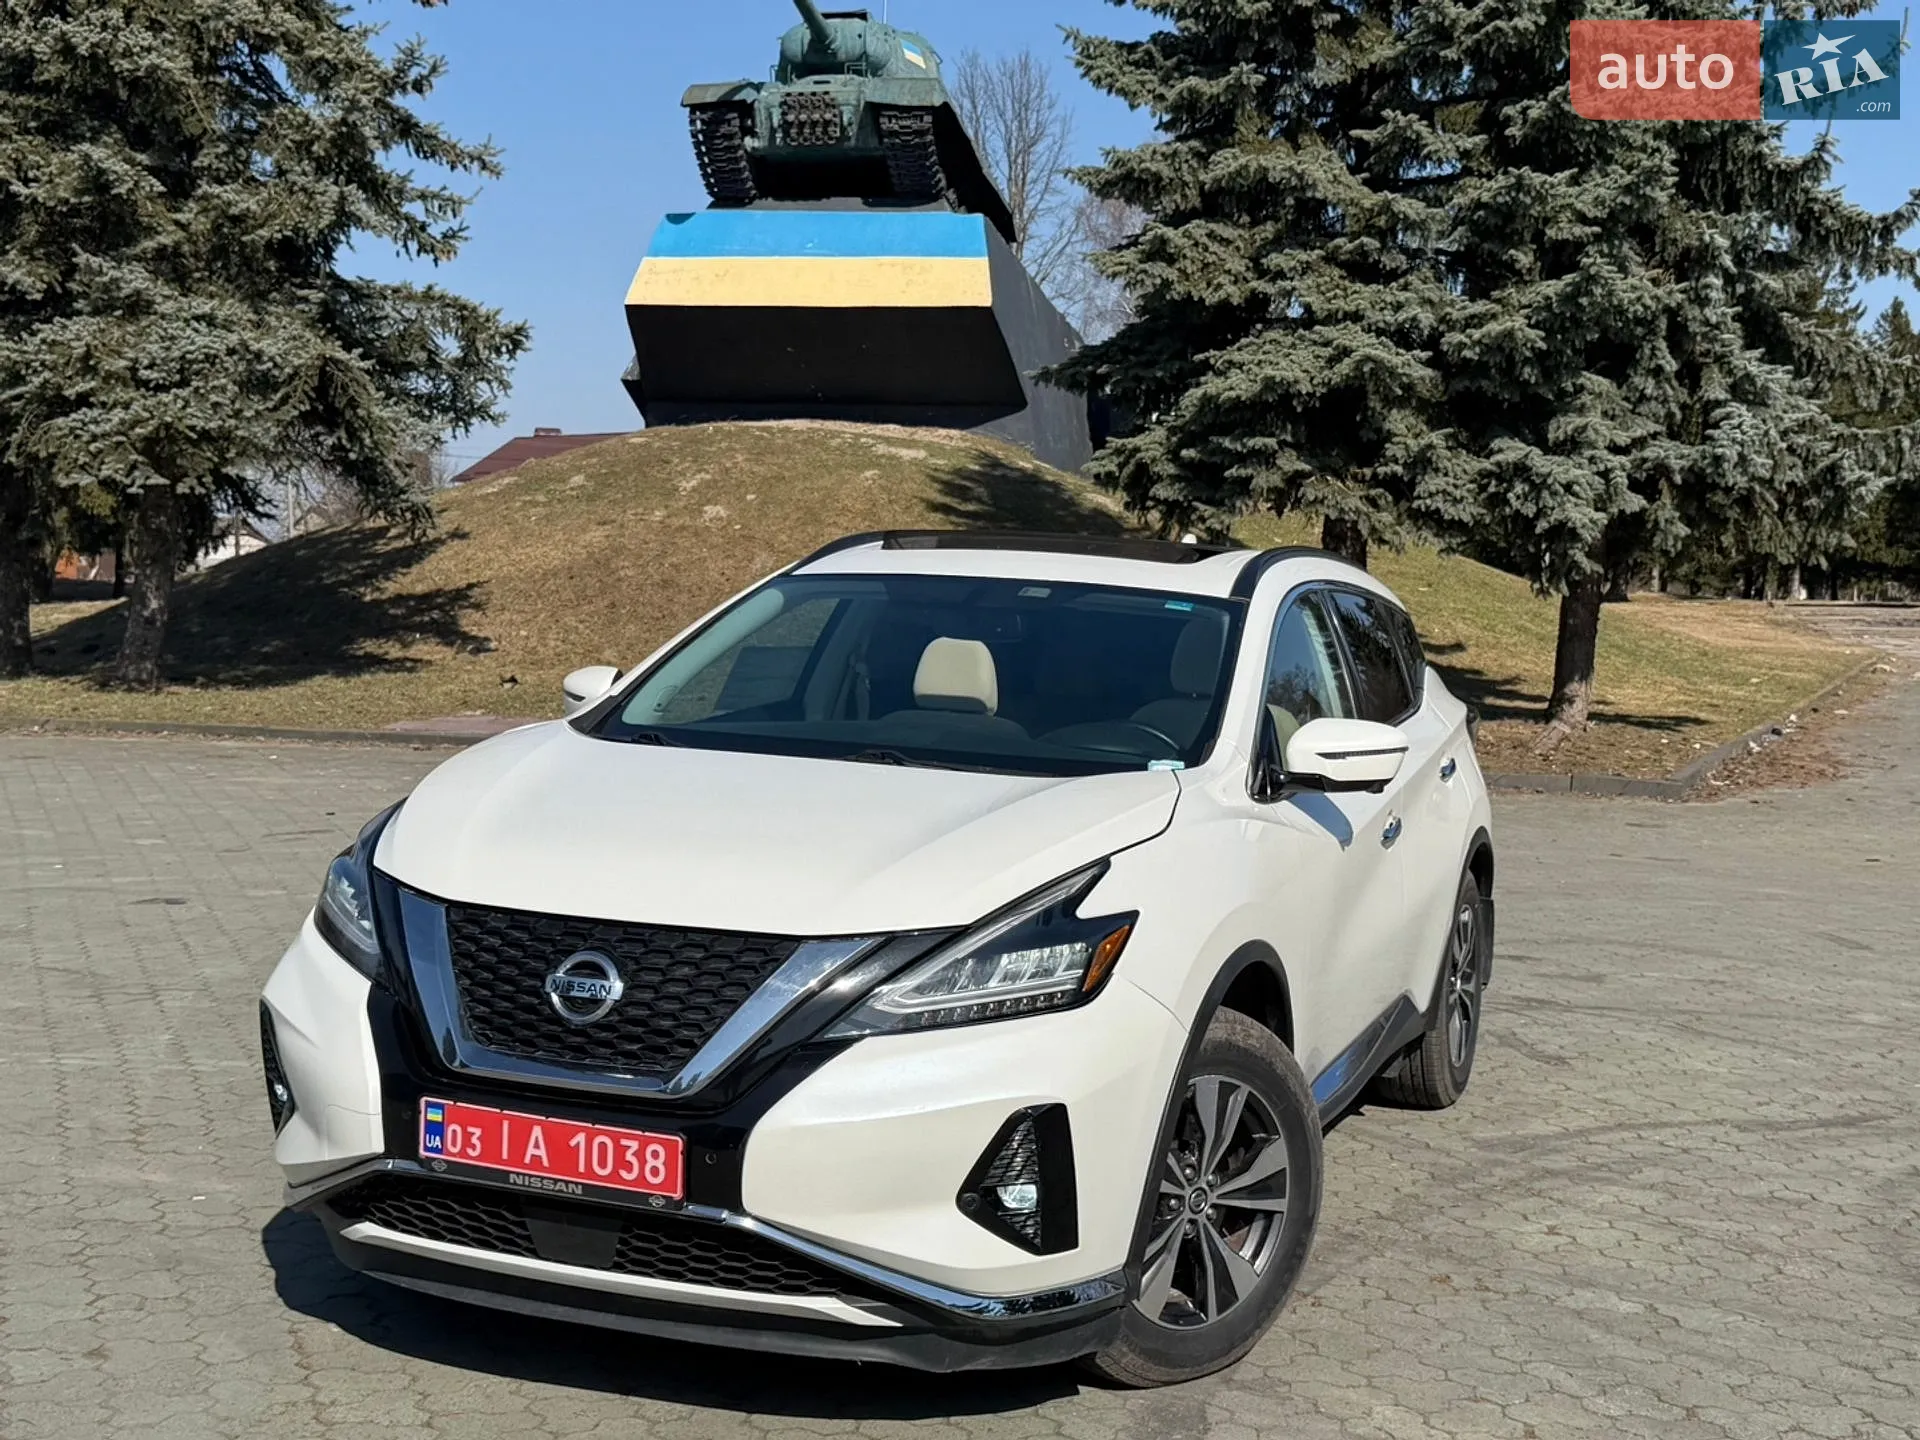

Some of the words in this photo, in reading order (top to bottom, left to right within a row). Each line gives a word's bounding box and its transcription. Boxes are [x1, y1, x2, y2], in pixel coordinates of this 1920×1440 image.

[550, 979, 612, 996] NISSAN
[425, 1133, 442, 1149] UA
[447, 1123, 482, 1157] 03
[502, 1119, 549, 1167] IA
[569, 1131, 666, 1185] 1038
[509, 1173, 583, 1194] NISSAN
